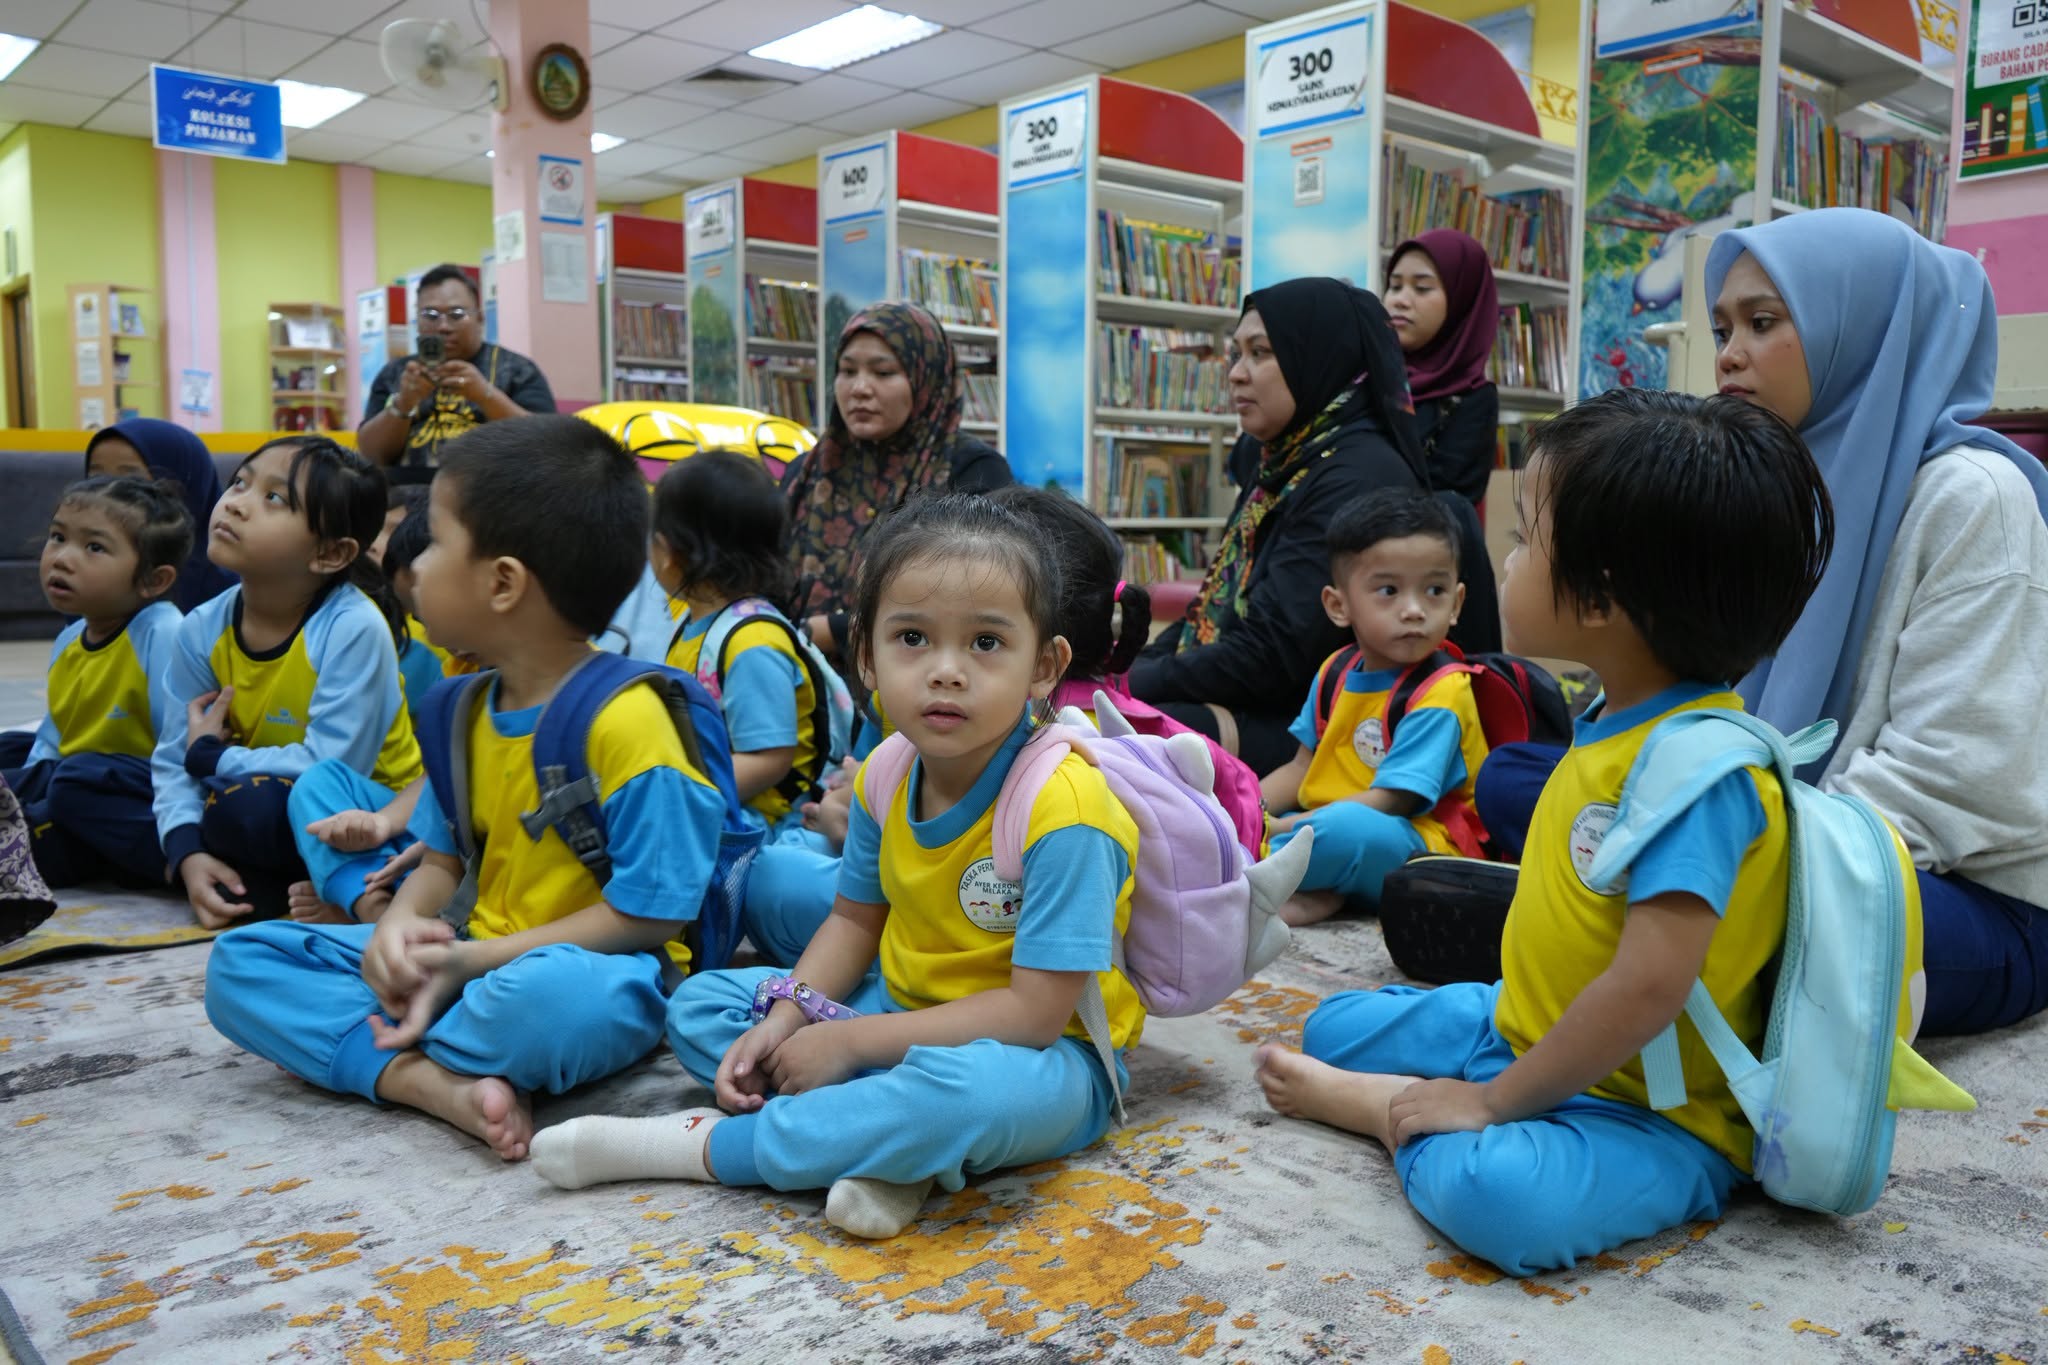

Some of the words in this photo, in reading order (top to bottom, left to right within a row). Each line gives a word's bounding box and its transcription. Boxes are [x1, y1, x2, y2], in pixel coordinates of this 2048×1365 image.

[1289, 47, 1333, 81] 300
[1981, 47, 2021, 67] BORANG
[2000, 61, 2035, 79] BAHAN
[190, 109, 251, 129] KOLEKSI
[184, 123, 256, 145] PINJAMAN
[1026, 116, 1058, 143] 300
[961, 869, 978, 891] TASKA
[974, 880, 991, 890] AYER
[982, 887, 1012, 895] MELAKA
